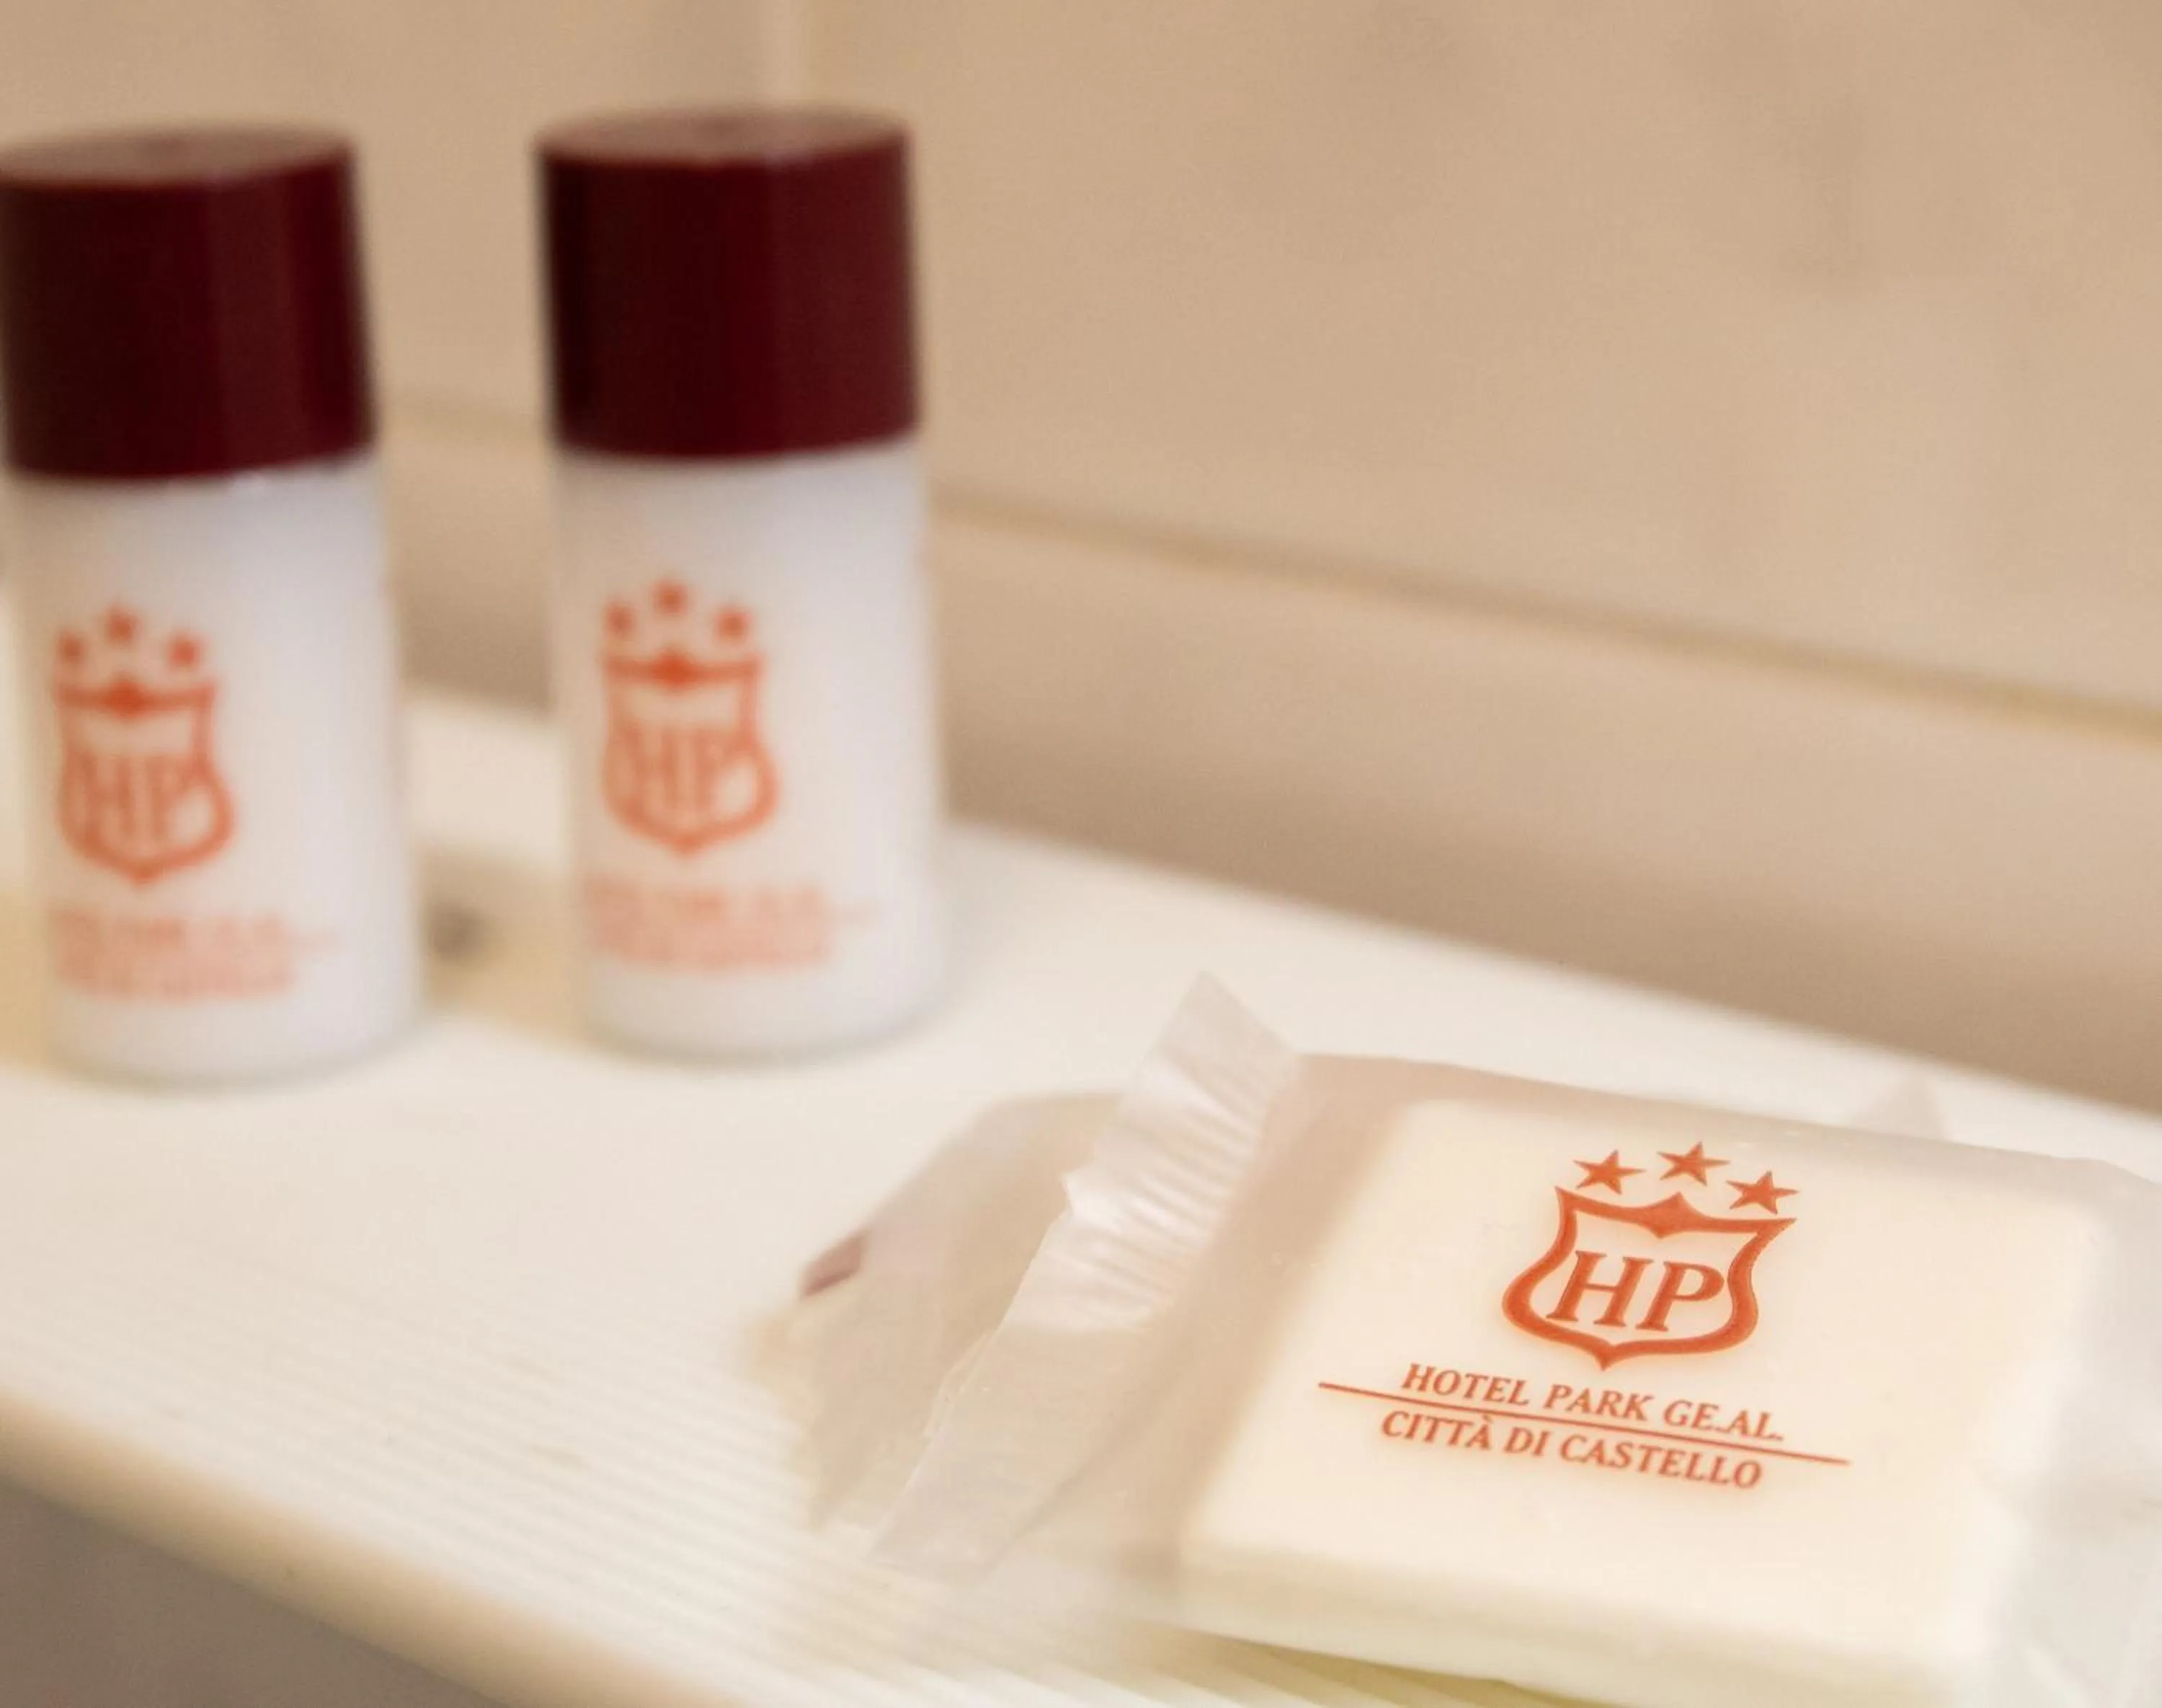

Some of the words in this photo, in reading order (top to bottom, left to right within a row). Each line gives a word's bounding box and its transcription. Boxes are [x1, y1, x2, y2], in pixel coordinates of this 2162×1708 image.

[1546, 1250, 1725, 1332] HP
[1401, 1363, 1529, 1407] HOTEL
[1544, 1384, 1652, 1422] PARK
[1663, 1400, 1784, 1441] GE.AL.
[1381, 1410, 1493, 1451] CITTÀ
[1505, 1428, 1545, 1456] DI
[1560, 1435, 1762, 1489] CASTELLO
